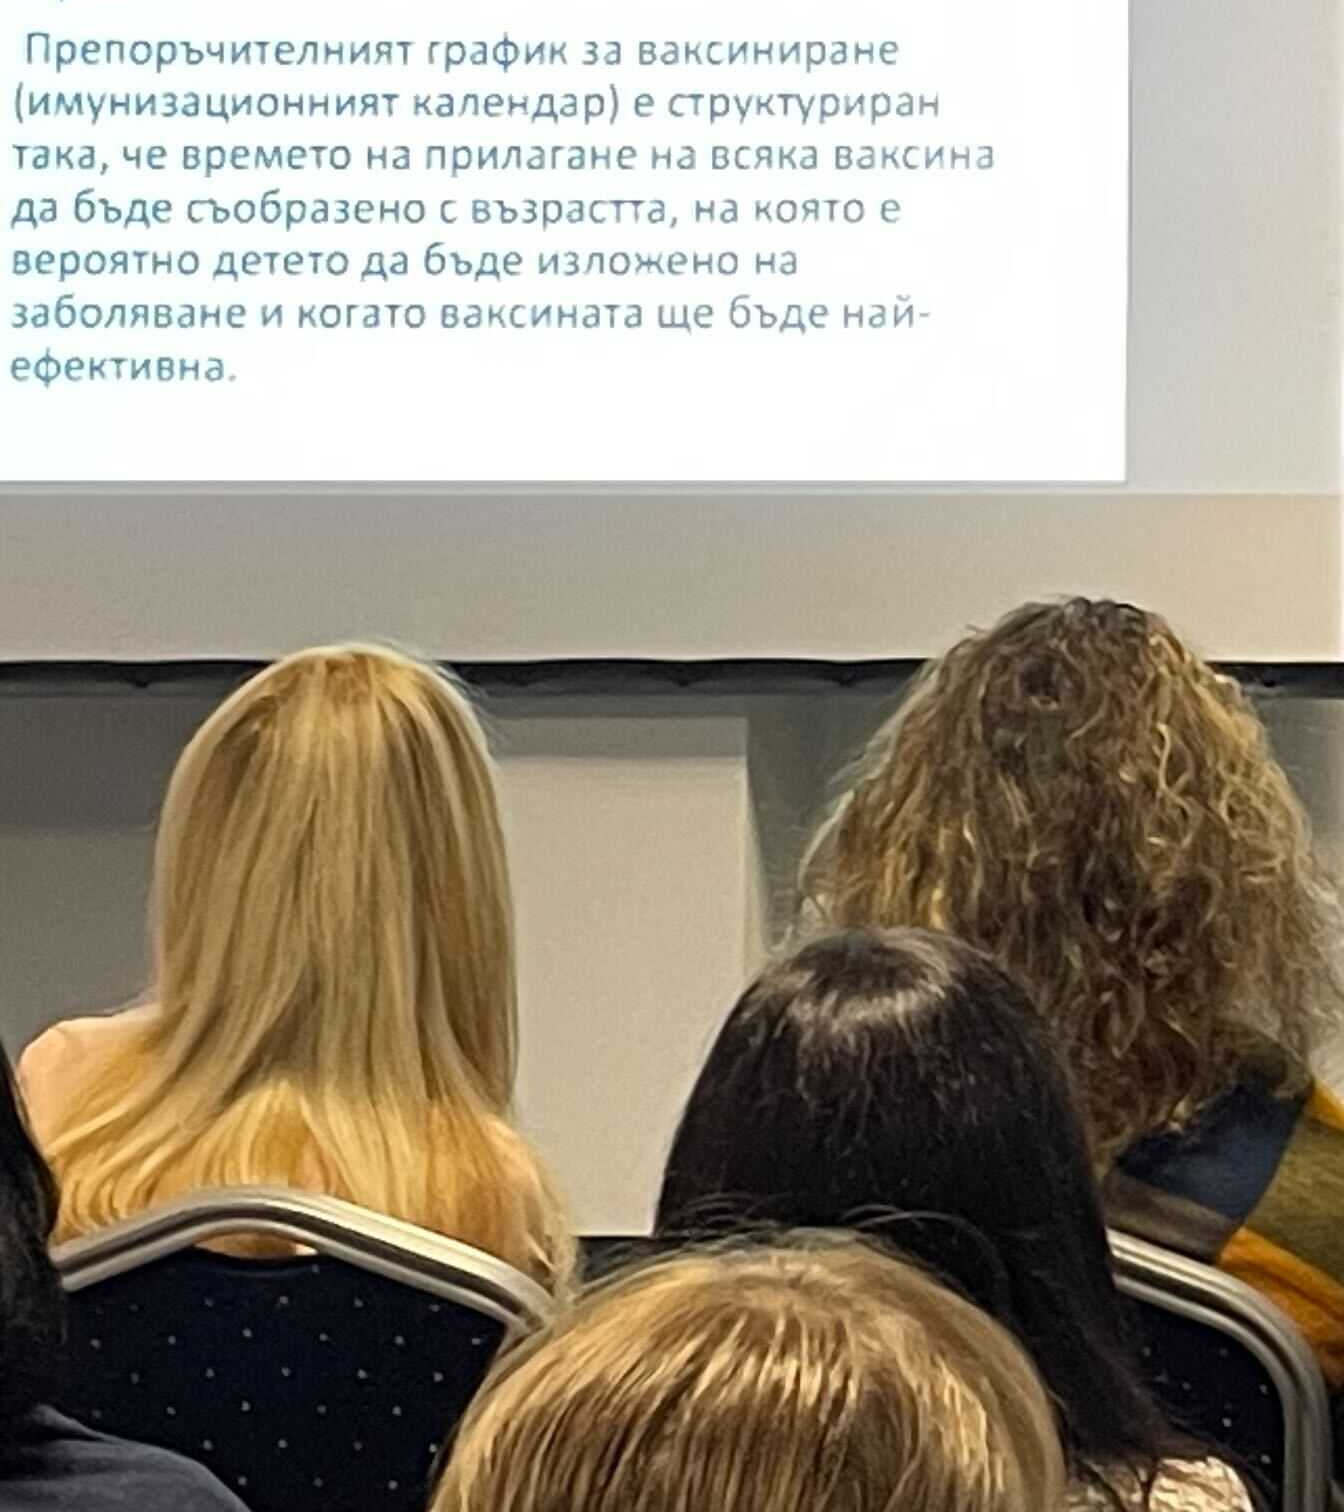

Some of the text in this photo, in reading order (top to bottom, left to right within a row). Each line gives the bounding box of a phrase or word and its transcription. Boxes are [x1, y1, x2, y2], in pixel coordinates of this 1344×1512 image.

[26, 31, 899, 74] Препоръчителният график за ваксиниране
[14, 81, 939, 125] (имунизационният календар) е структуриран
[12, 144, 994, 178] така, че времето на прилагане на всяка ваксина
[10, 188, 901, 232] да бъде съобразено с възрастта, на която е
[12, 242, 797, 282] вероятно детето да бъде изложено на
[11, 293, 929, 335] заболяване и когато ваксината ще бъде най-
[10, 347, 236, 389] ефективна.
